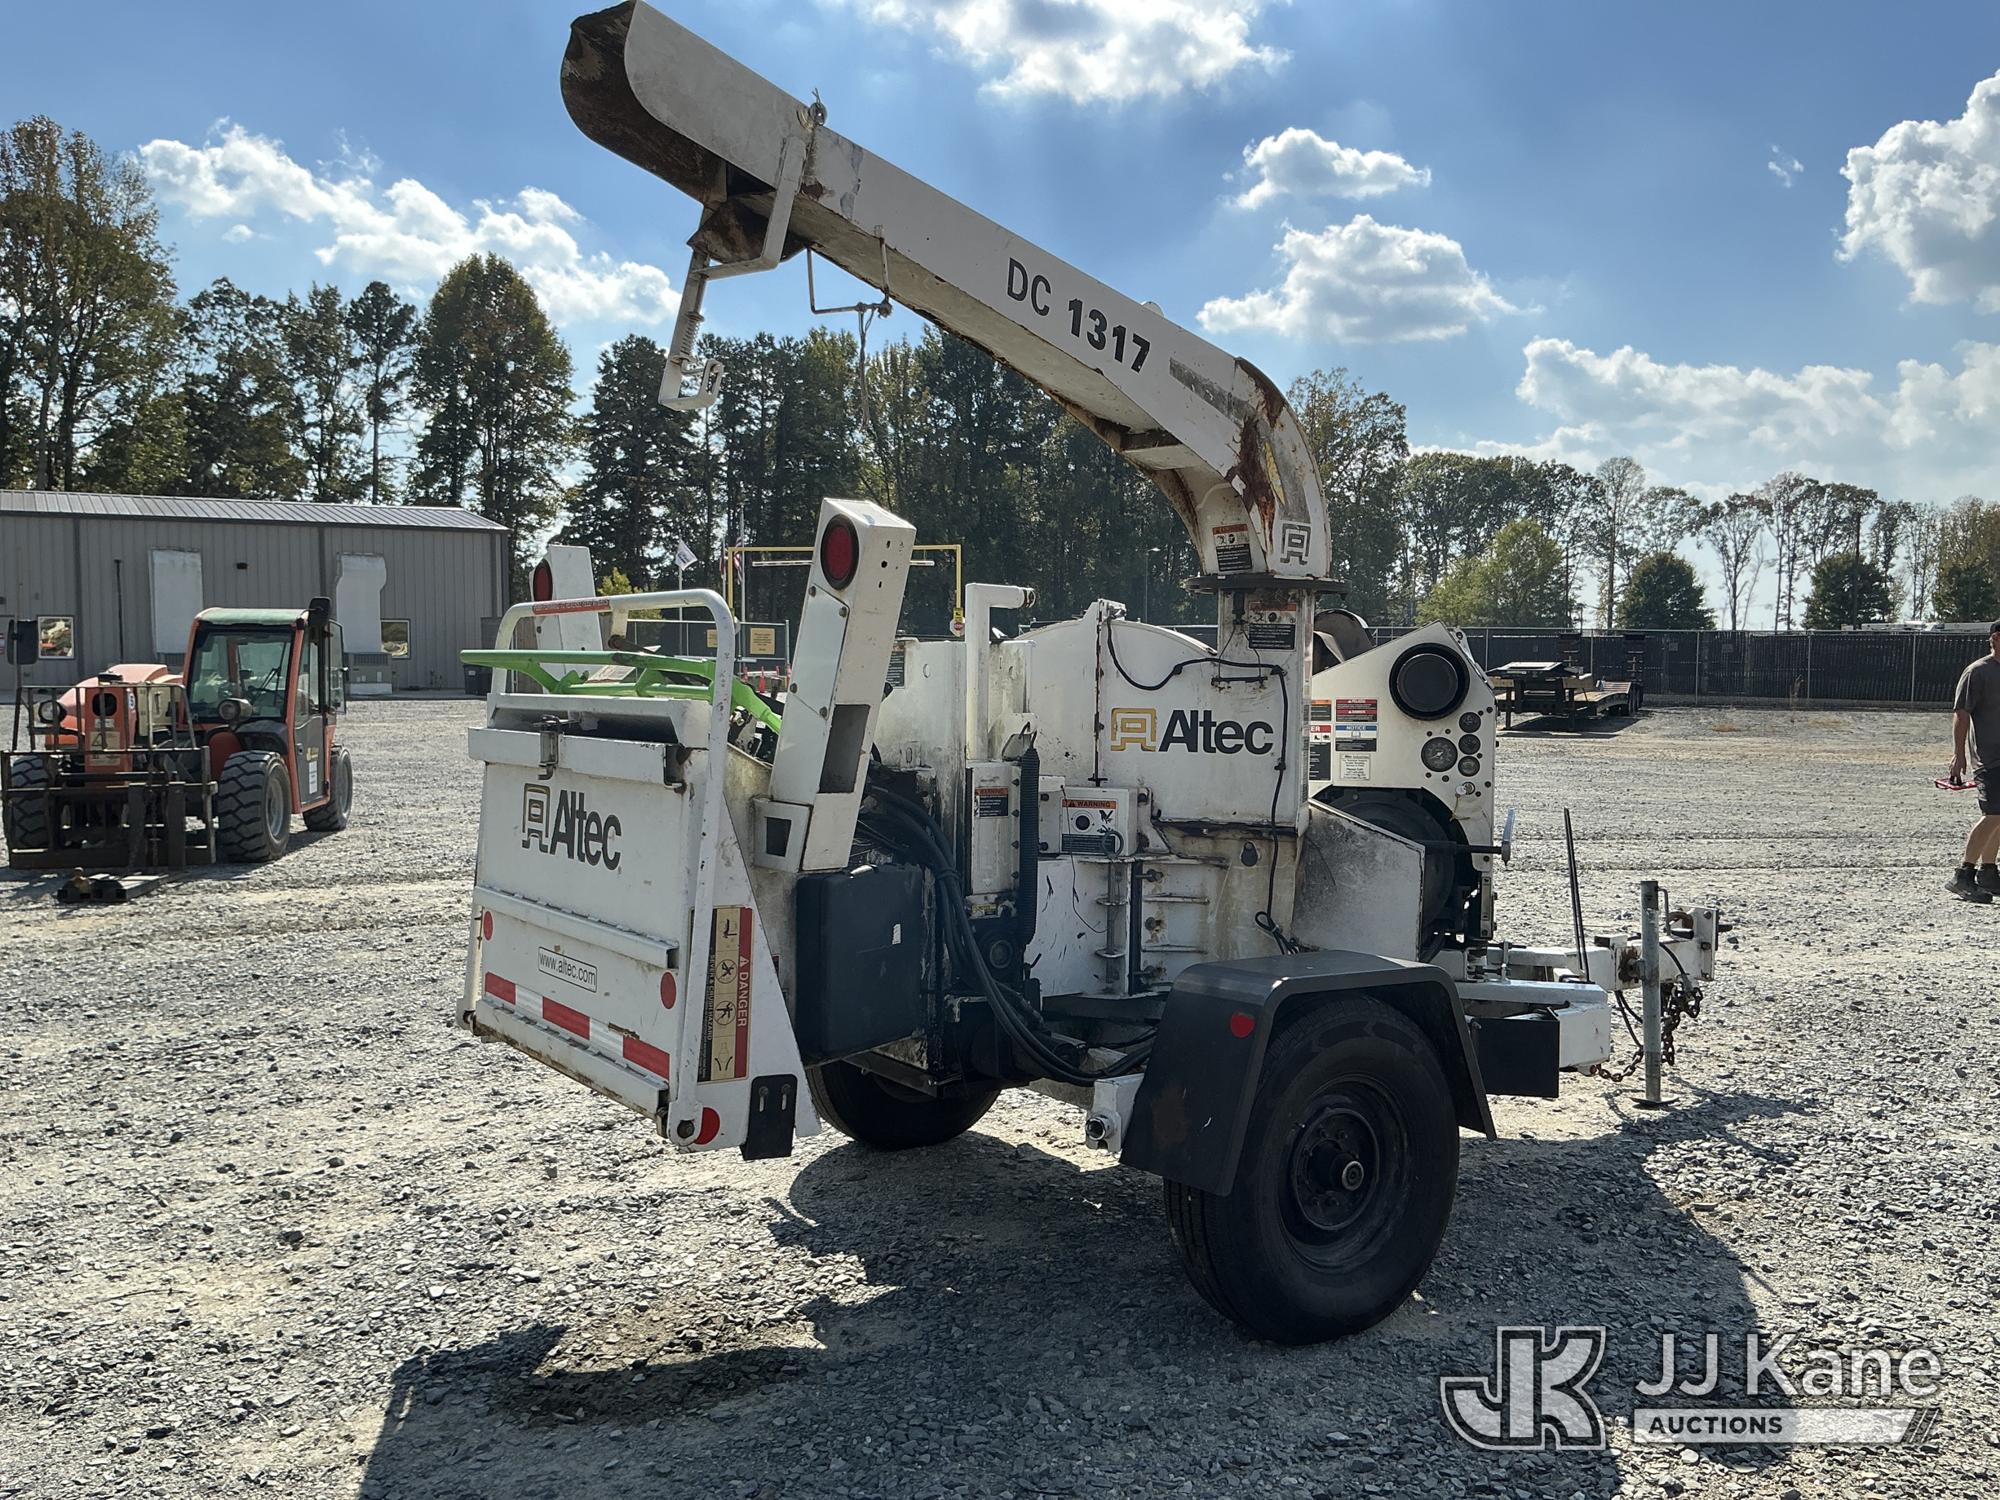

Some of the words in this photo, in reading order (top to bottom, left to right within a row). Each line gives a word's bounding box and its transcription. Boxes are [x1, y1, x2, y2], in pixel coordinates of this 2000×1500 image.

[1007, 257, 1051, 316] DC
[1068, 298, 1150, 373] 1317
[1158, 709, 1274, 754] Altec
[1077, 800, 1111, 808] WARNING
[550, 789, 622, 870] Altec
[539, 951, 596, 985] www.altec.com
[737, 972, 748, 1027] DANGER
